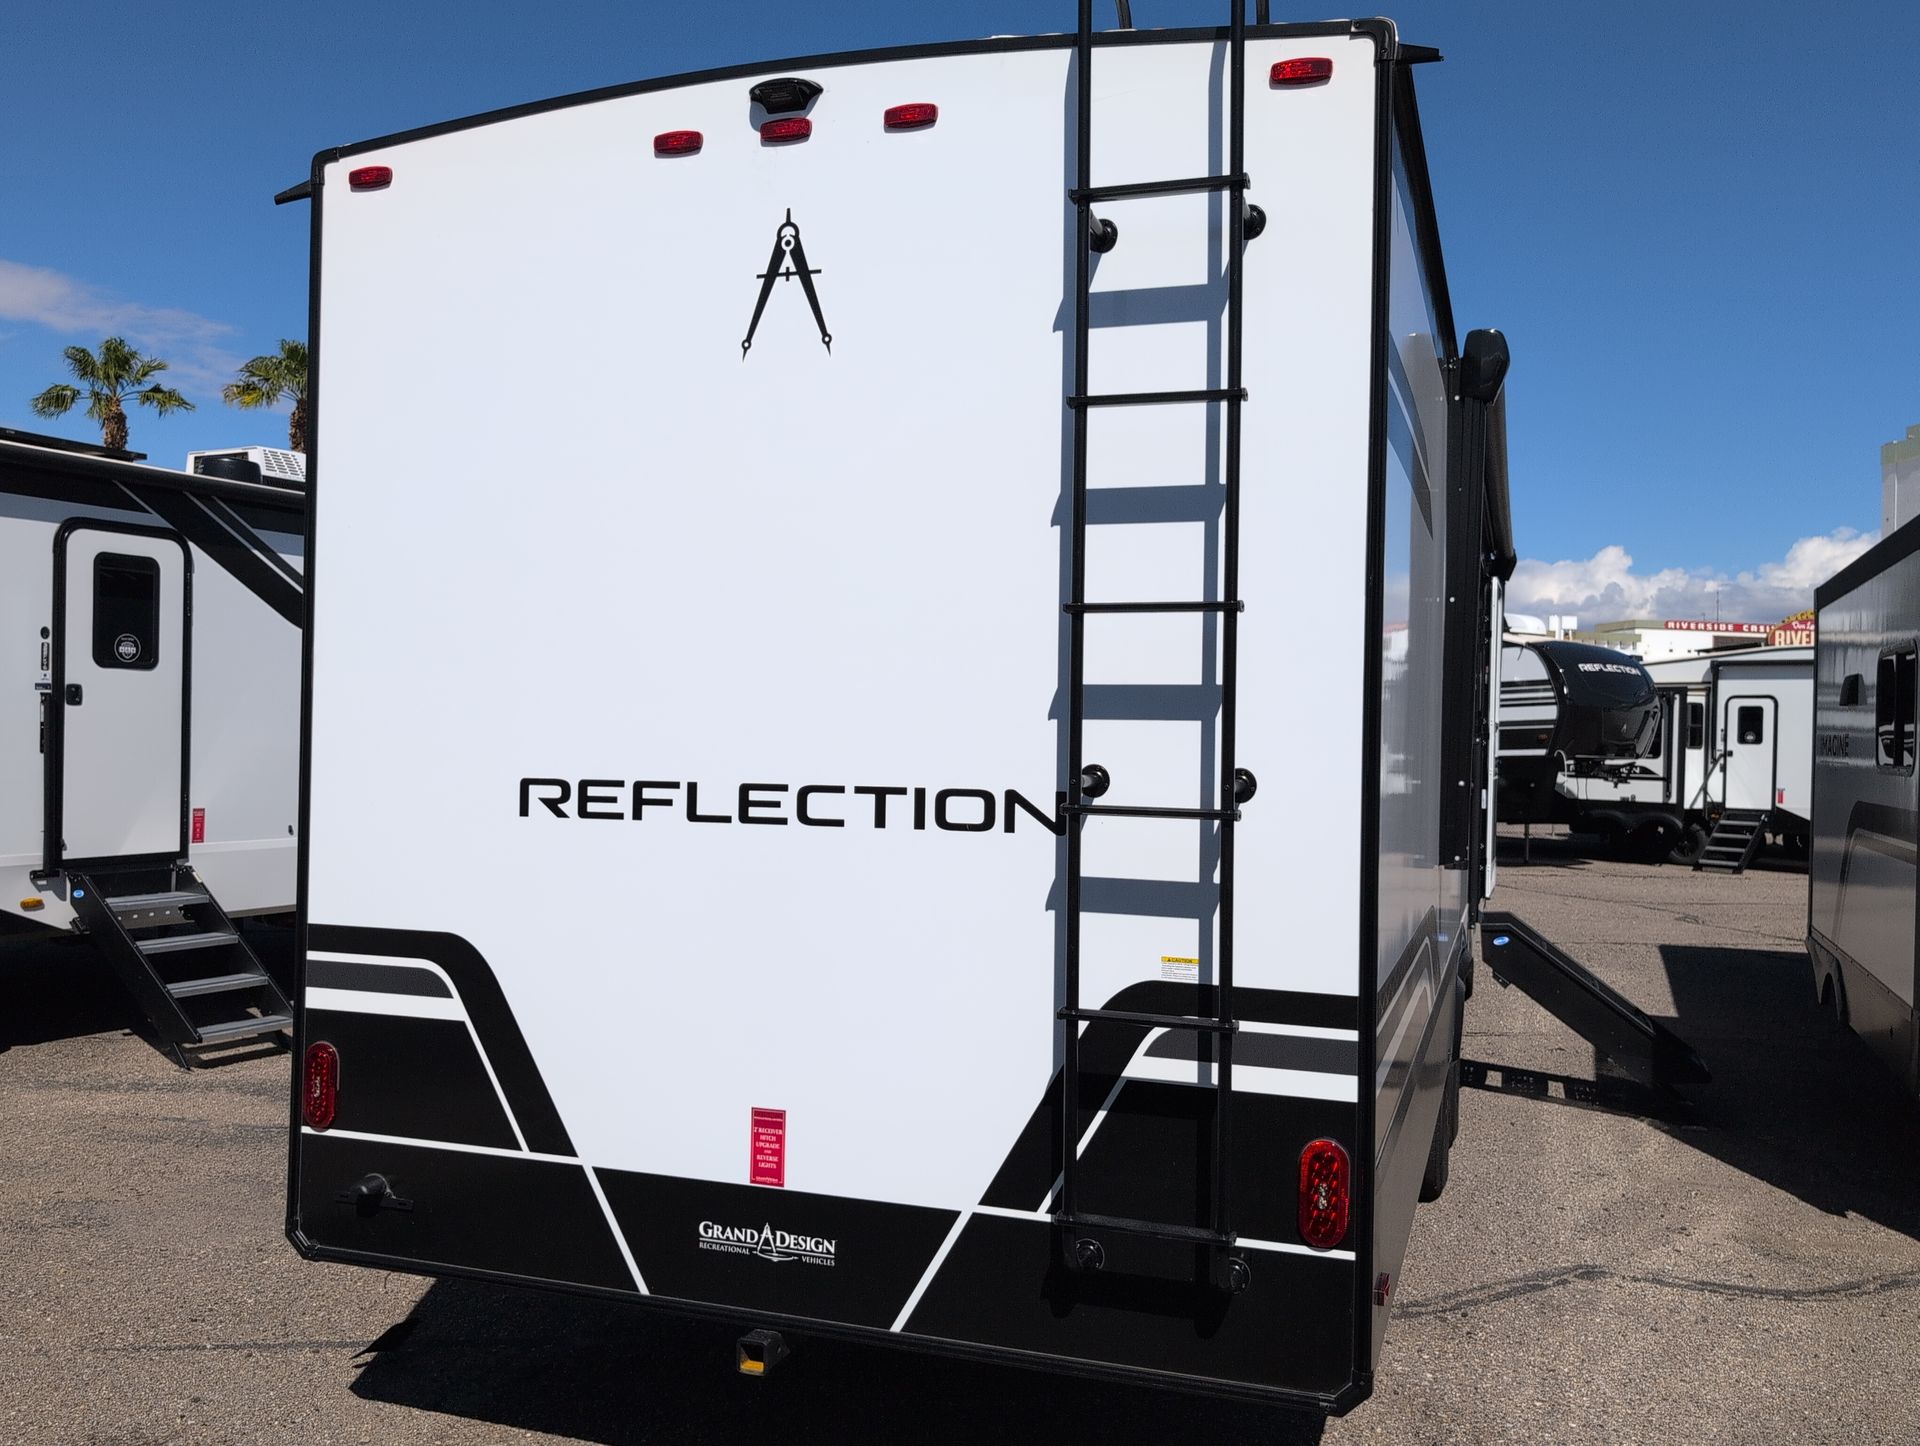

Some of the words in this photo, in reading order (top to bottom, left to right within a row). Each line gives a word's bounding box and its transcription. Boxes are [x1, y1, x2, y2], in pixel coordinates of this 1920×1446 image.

[1667, 621, 1734, 632] RIVERSIDE
[1578, 663, 1641, 676] REFLECTION
[519, 776, 1068, 836] REFLECTION
[699, 1220, 759, 1244] GRAND
[775, 1230, 836, 1254] DESIGN
[699, 1241, 751, 1255] RECREATIONAL
[801, 1255, 835, 1267] VEHICLES
